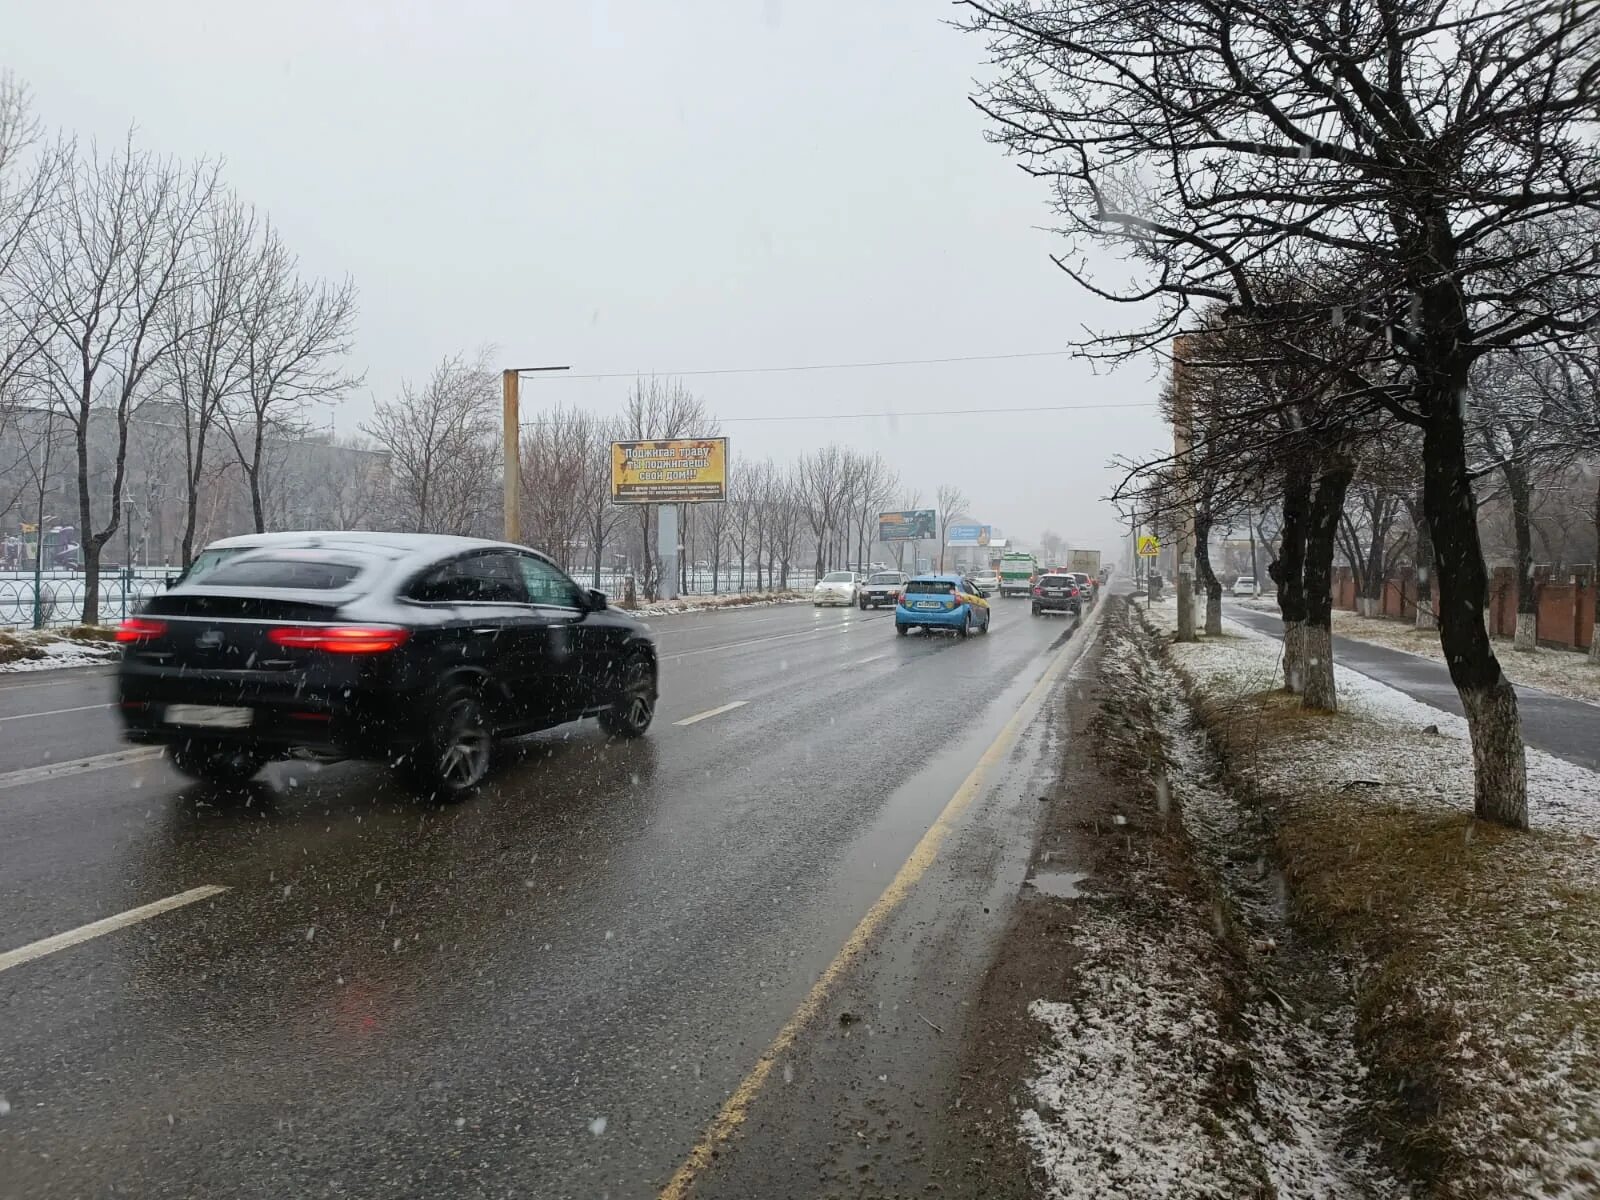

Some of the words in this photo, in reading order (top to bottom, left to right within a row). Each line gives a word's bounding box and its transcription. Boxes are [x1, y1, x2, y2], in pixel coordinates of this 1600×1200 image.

[625, 448, 675, 459] Поджигая
[627, 460, 640, 469] ты
[645, 459, 710, 469] поджигаешь
[666, 469, 696, 481] дом!!!
